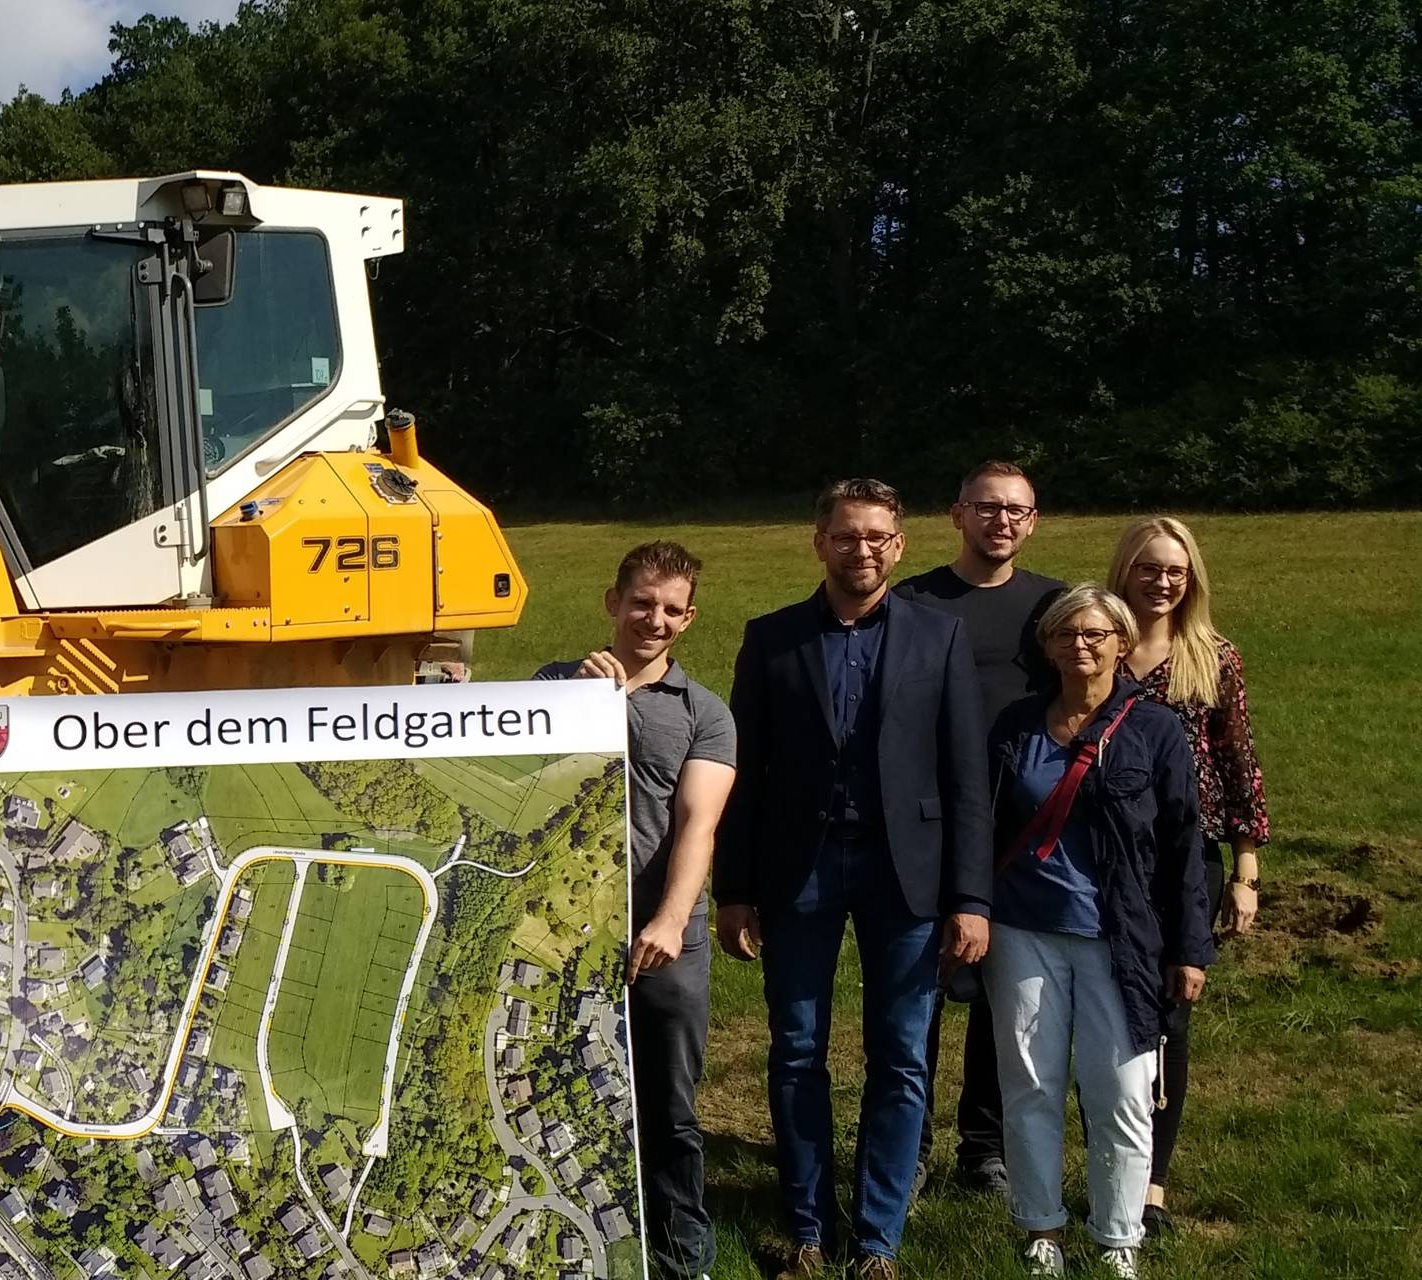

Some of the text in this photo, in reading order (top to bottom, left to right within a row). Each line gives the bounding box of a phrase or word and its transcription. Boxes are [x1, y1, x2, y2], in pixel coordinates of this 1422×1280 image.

[302, 535, 400, 574] 726
[53, 702, 552, 751] Ober dem Feldgarten
